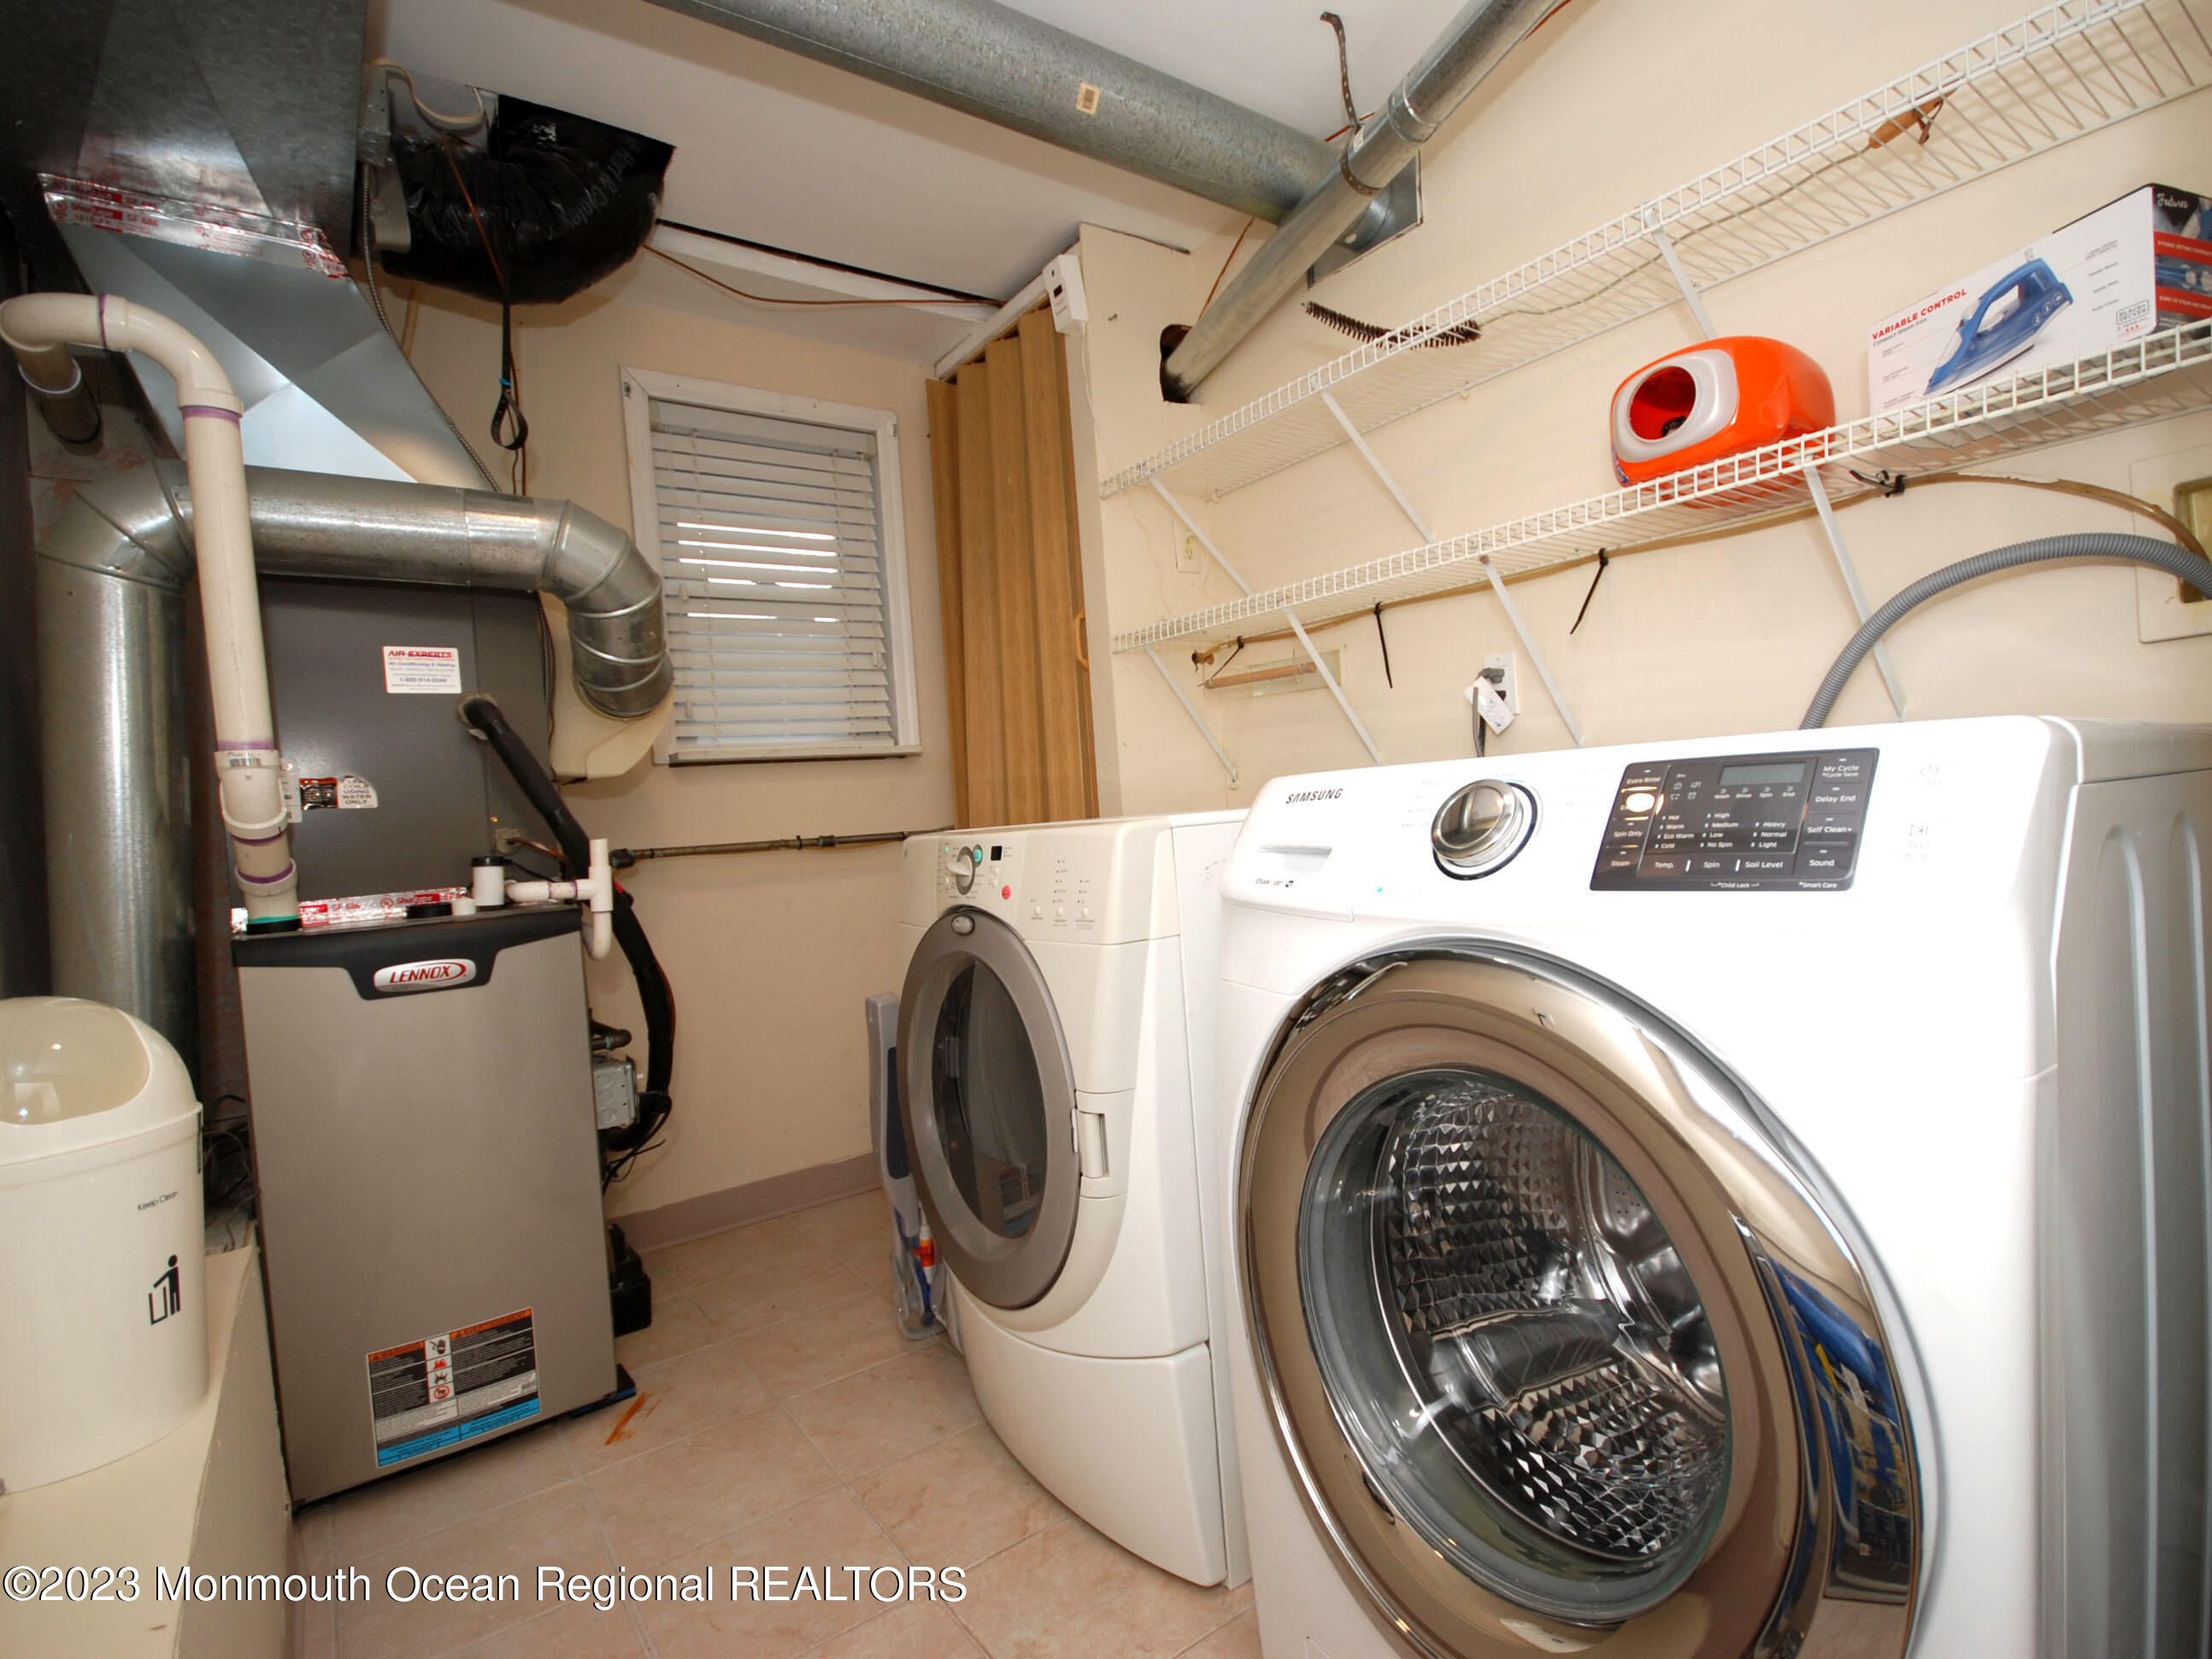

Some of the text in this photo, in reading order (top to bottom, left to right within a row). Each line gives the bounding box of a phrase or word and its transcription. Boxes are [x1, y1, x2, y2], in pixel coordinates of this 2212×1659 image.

[2156, 192, 2189, 209] Features
[1872, 289, 1968, 340] VARIABLE CONTROL
[1285, 788, 1344, 805] SAMSUNG
[345, 902, 362, 911] 686
[389, 964, 452, 984] LENNOX
[138, 1191, 179, 1211] Keep Clean
